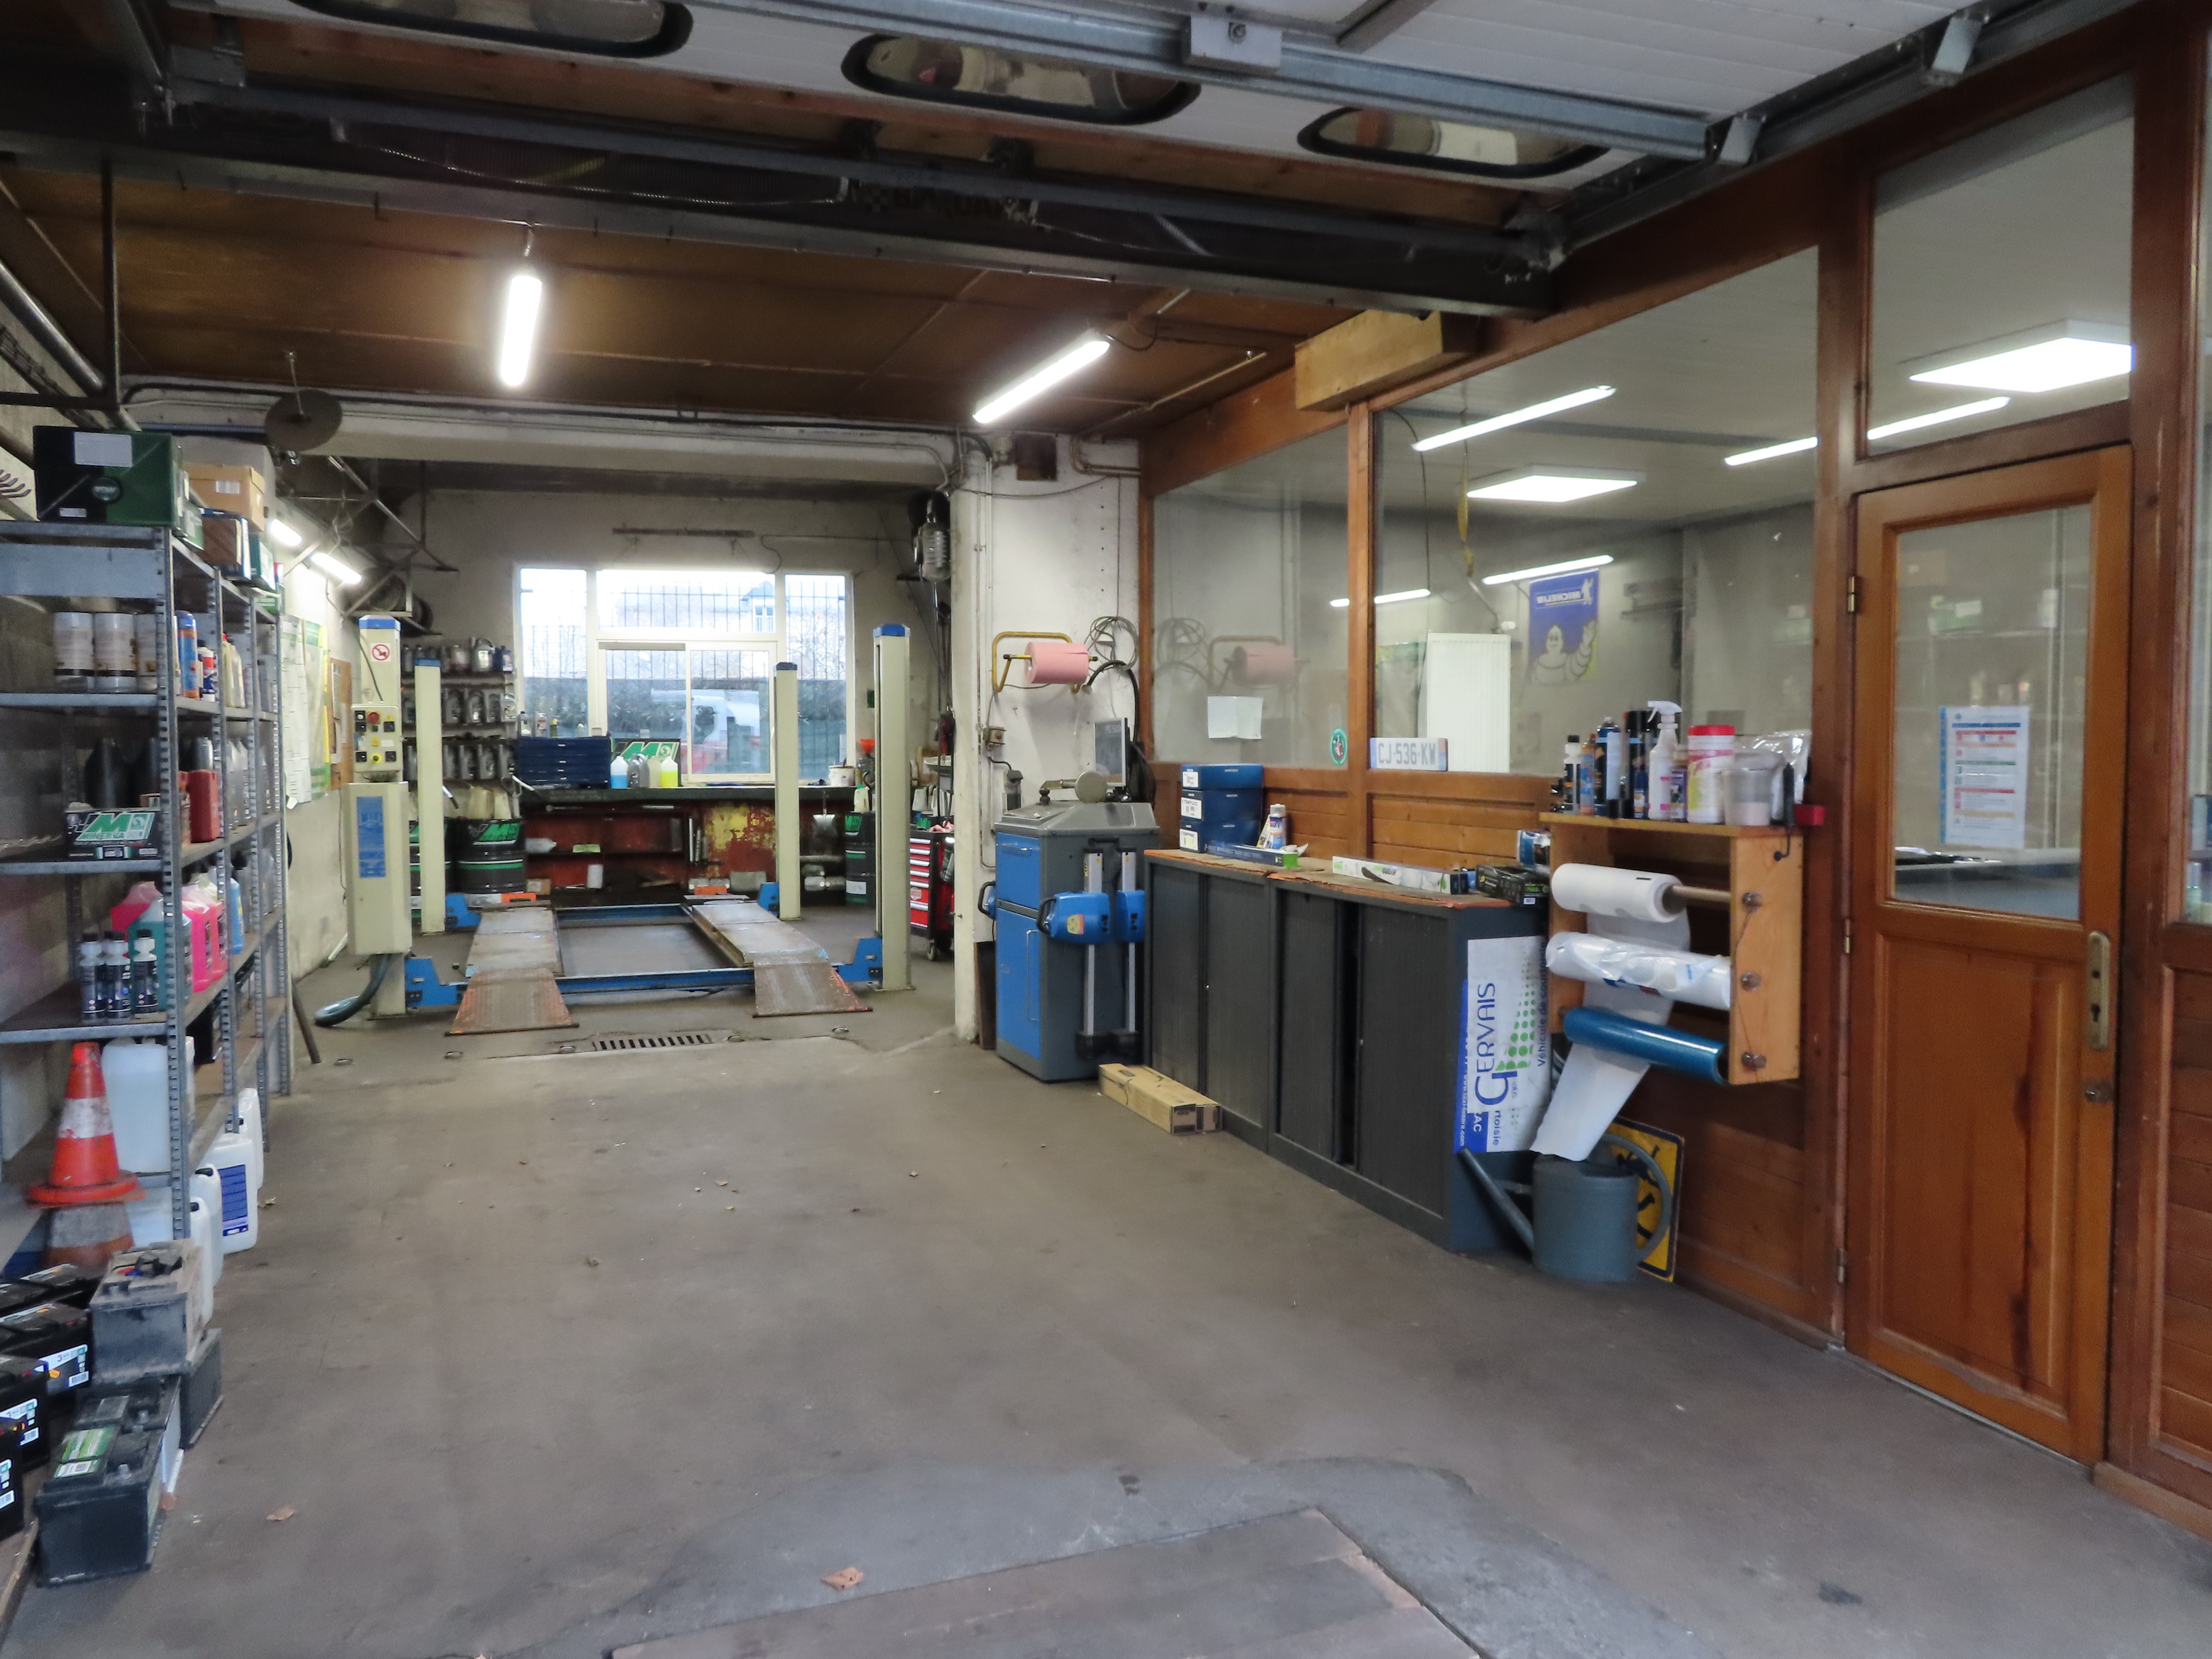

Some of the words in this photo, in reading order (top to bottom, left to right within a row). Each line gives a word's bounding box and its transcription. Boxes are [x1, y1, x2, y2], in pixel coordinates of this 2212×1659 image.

[1475, 982, 1518, 1106] GERVAIS
[1537, 1019, 1546, 1066] Véhicule
[1473, 1112, 1482, 1132] AC
